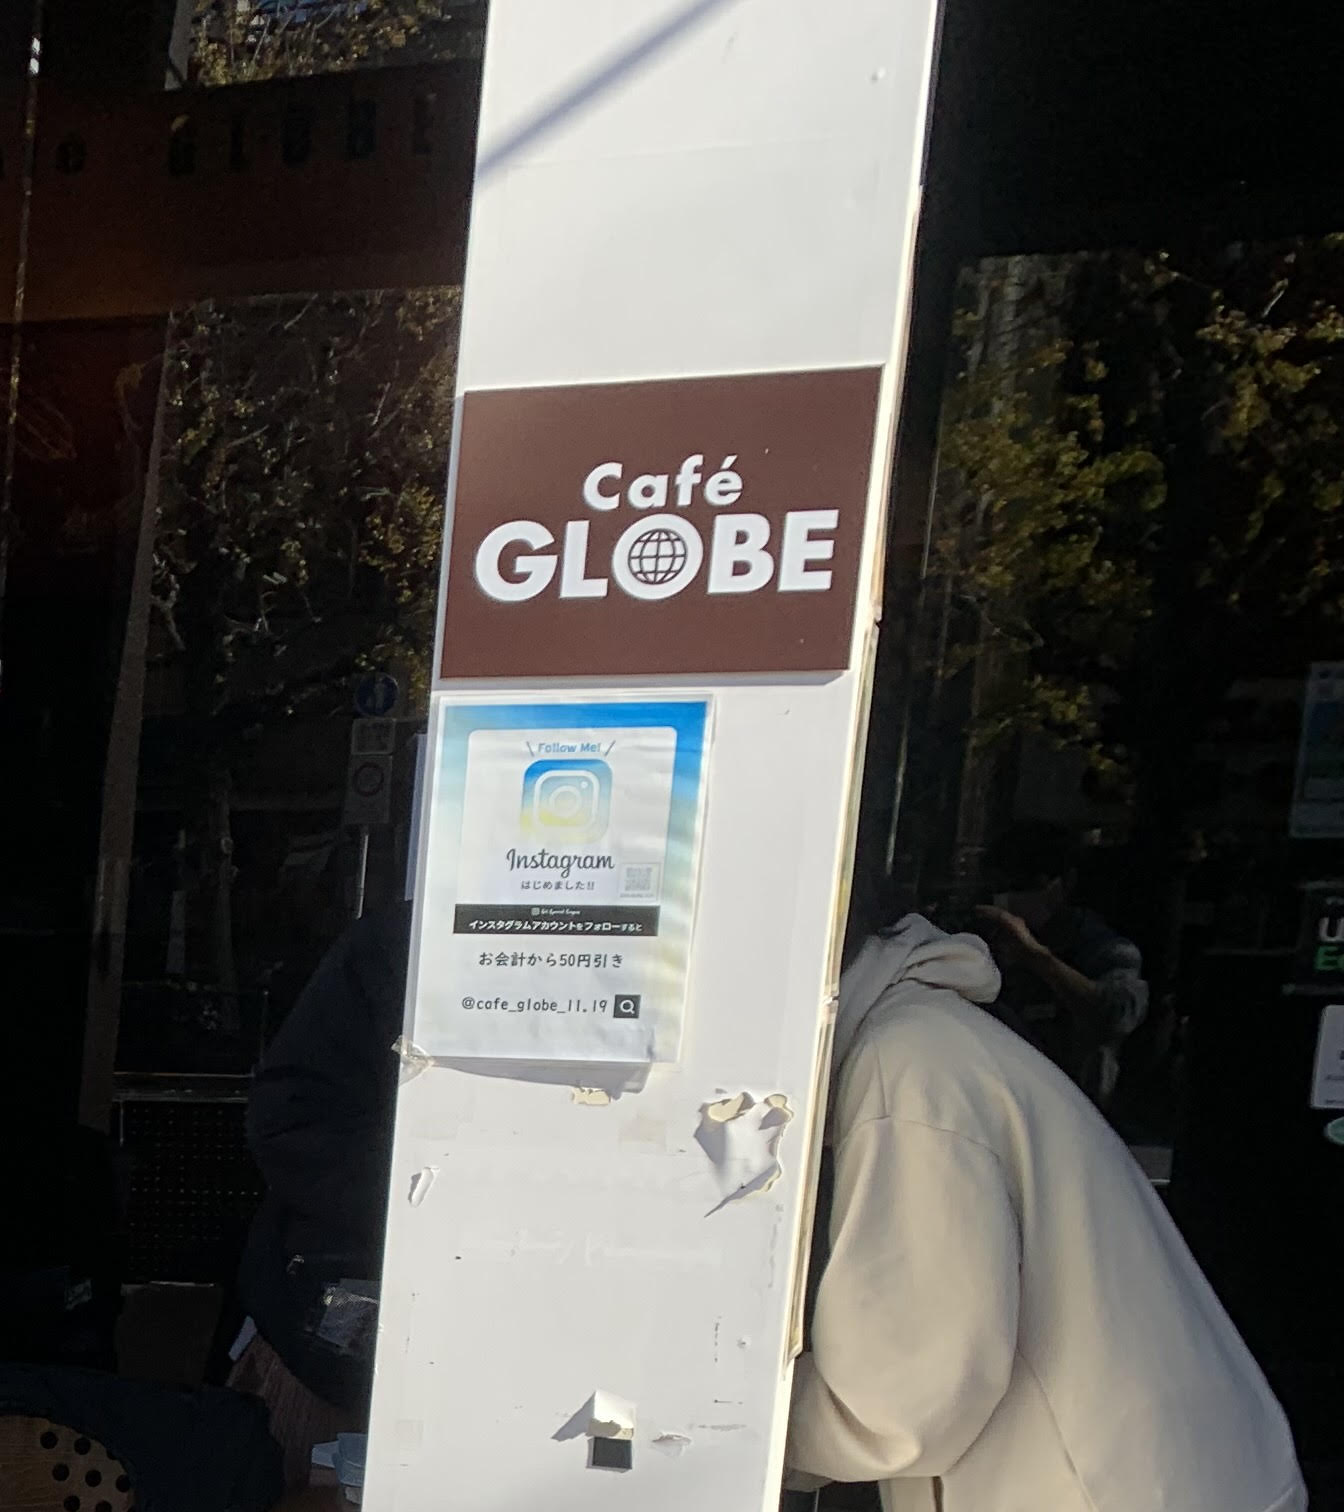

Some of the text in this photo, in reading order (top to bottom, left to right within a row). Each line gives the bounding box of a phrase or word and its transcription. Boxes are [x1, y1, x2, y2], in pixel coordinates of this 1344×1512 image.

[583, 454, 743, 511] Café
[474, 509, 840, 602] GLOBE
[537, 742, 602, 753] Follow Me!
[506, 848, 615, 879] Instagram
[468, 919, 643, 932] インスタグラムアカウントをフォローすると
[479, 951, 624, 969] お会計から50円引き
[461, 996, 608, 1014] @cafe_globe_11.19
